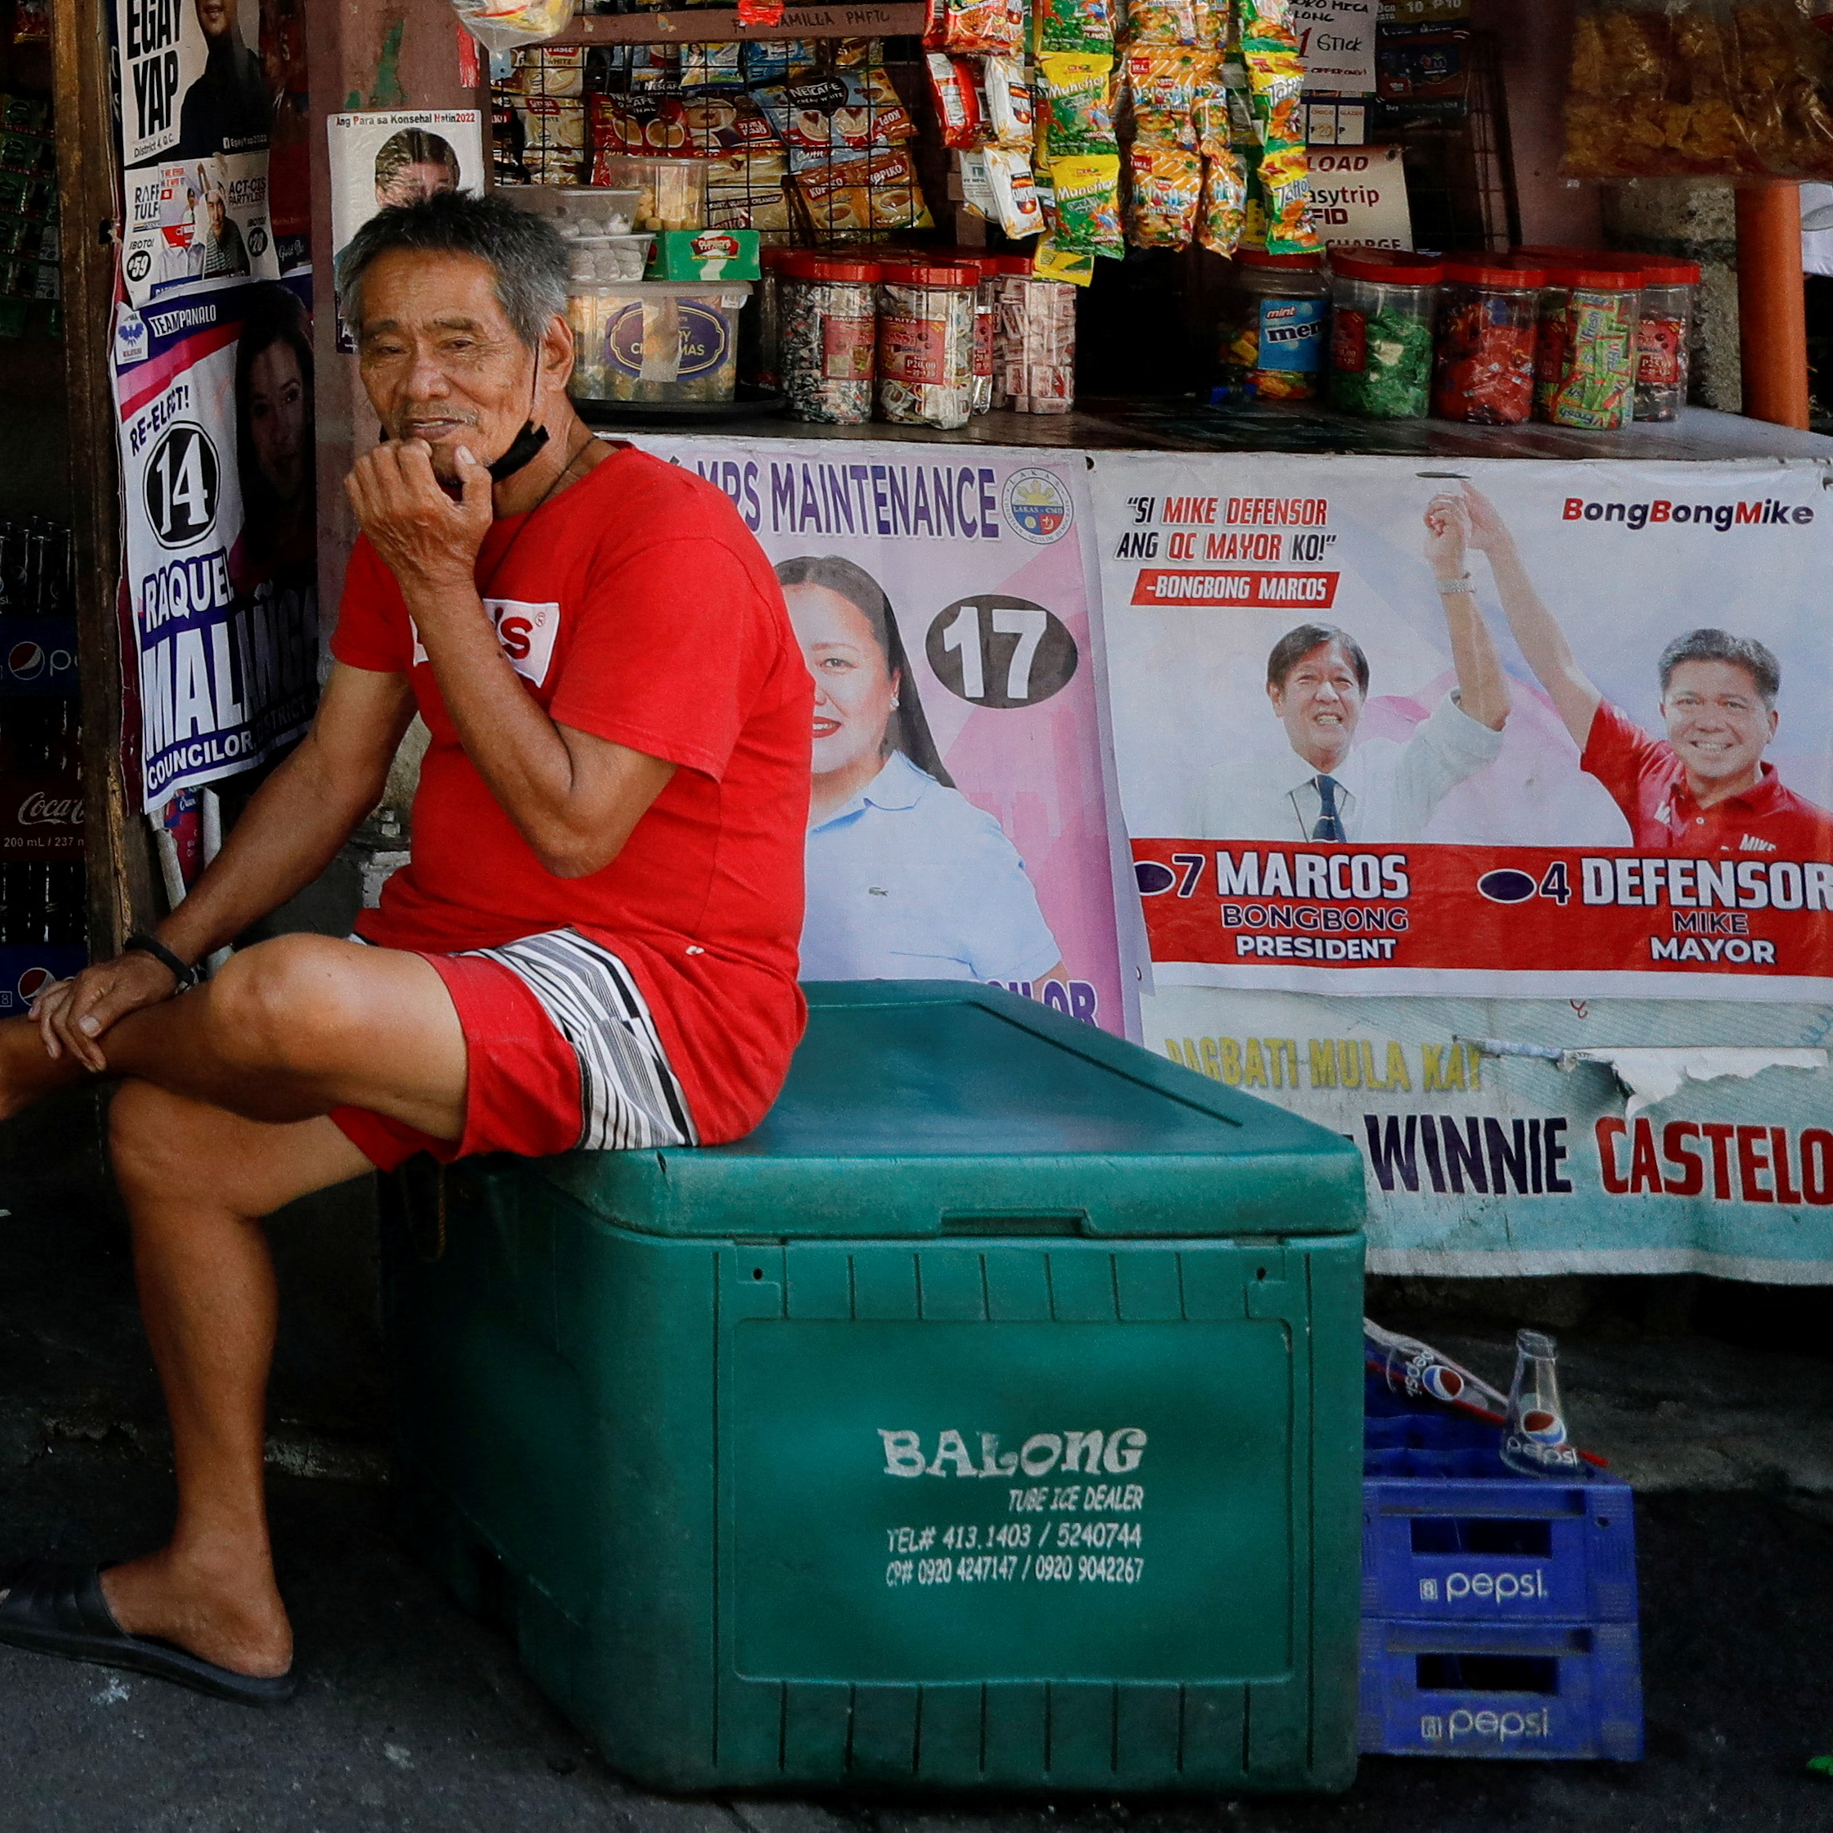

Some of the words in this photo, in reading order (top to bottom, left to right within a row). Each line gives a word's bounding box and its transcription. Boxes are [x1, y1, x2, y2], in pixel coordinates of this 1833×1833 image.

[133, 51, 179, 140] YAP
[353, 116, 374, 125] Para
[391, 115, 432, 124] Konsehal
[134, 142, 157, 158] District
[229, 177, 266, 195] ACT-CIS
[151, 312, 179, 337] TEAM
[180, 305, 216, 327] PANALO
[1266, 307, 1295, 319] mint
[129, 385, 190, 456] RE-ELECT!
[156, 433, 209, 527] 14
[770, 465, 1000, 539] MAINTENANCE
[1162, 496, 1216, 523] MIKE
[1226, 496, 1327, 526] DEFENSOR
[1562, 496, 1814, 531] BongBongMike
[1116, 532, 1159, 560] ANG
[1168, 534, 1196, 562] QC
[1206, 533, 1282, 562] MAYOR
[145, 548, 233, 632] RAQUEL
[1145, 576, 1250, 601] -BONGBONG
[1259, 577, 1327, 601] MARCOS
[943, 605, 1047, 698] 17
[3, 837, 23, 847] 200
[26, 837, 45, 847] mL
[1217, 851, 1410, 898] MARCOS
[1581, 859, 1833, 910] DEFENSOR
[1222, 903, 1409, 931] BONGBONG
[1673, 910, 1748, 935] MIKE
[1236, 936, 1397, 960] PRESIDENT
[1651, 937, 1775, 964] MAYOR
[1308, 1040, 1411, 1091] MULA
[1421, 1041, 1482, 1092] KAY
[1364, 1113, 1572, 1194] WINNIE
[877, 1428, 1147, 1478] BALONG
[1506, 1437, 1579, 1467] pepsi
[1009, 1487, 1048, 1511] TUBE
[1051, 1486, 1078, 1510] ICE
[1084, 1485, 1144, 1511] DEALER
[887, 1527, 936, 1553] TEL#
[942, 1523, 1032, 1550] 413.1403
[1057, 1523, 1142, 1549] 5240744
[886, 1561, 913, 1587] CP#
[918, 1557, 952, 1584] 0920
[956, 1555, 1018, 1582] 4247147
[1035, 1555, 1072, 1582] 0920
[1078, 1556, 1144, 1583] 9042267
[1446, 1570, 1548, 1603] pepsi
[1449, 1709, 1550, 1742] pepsi
